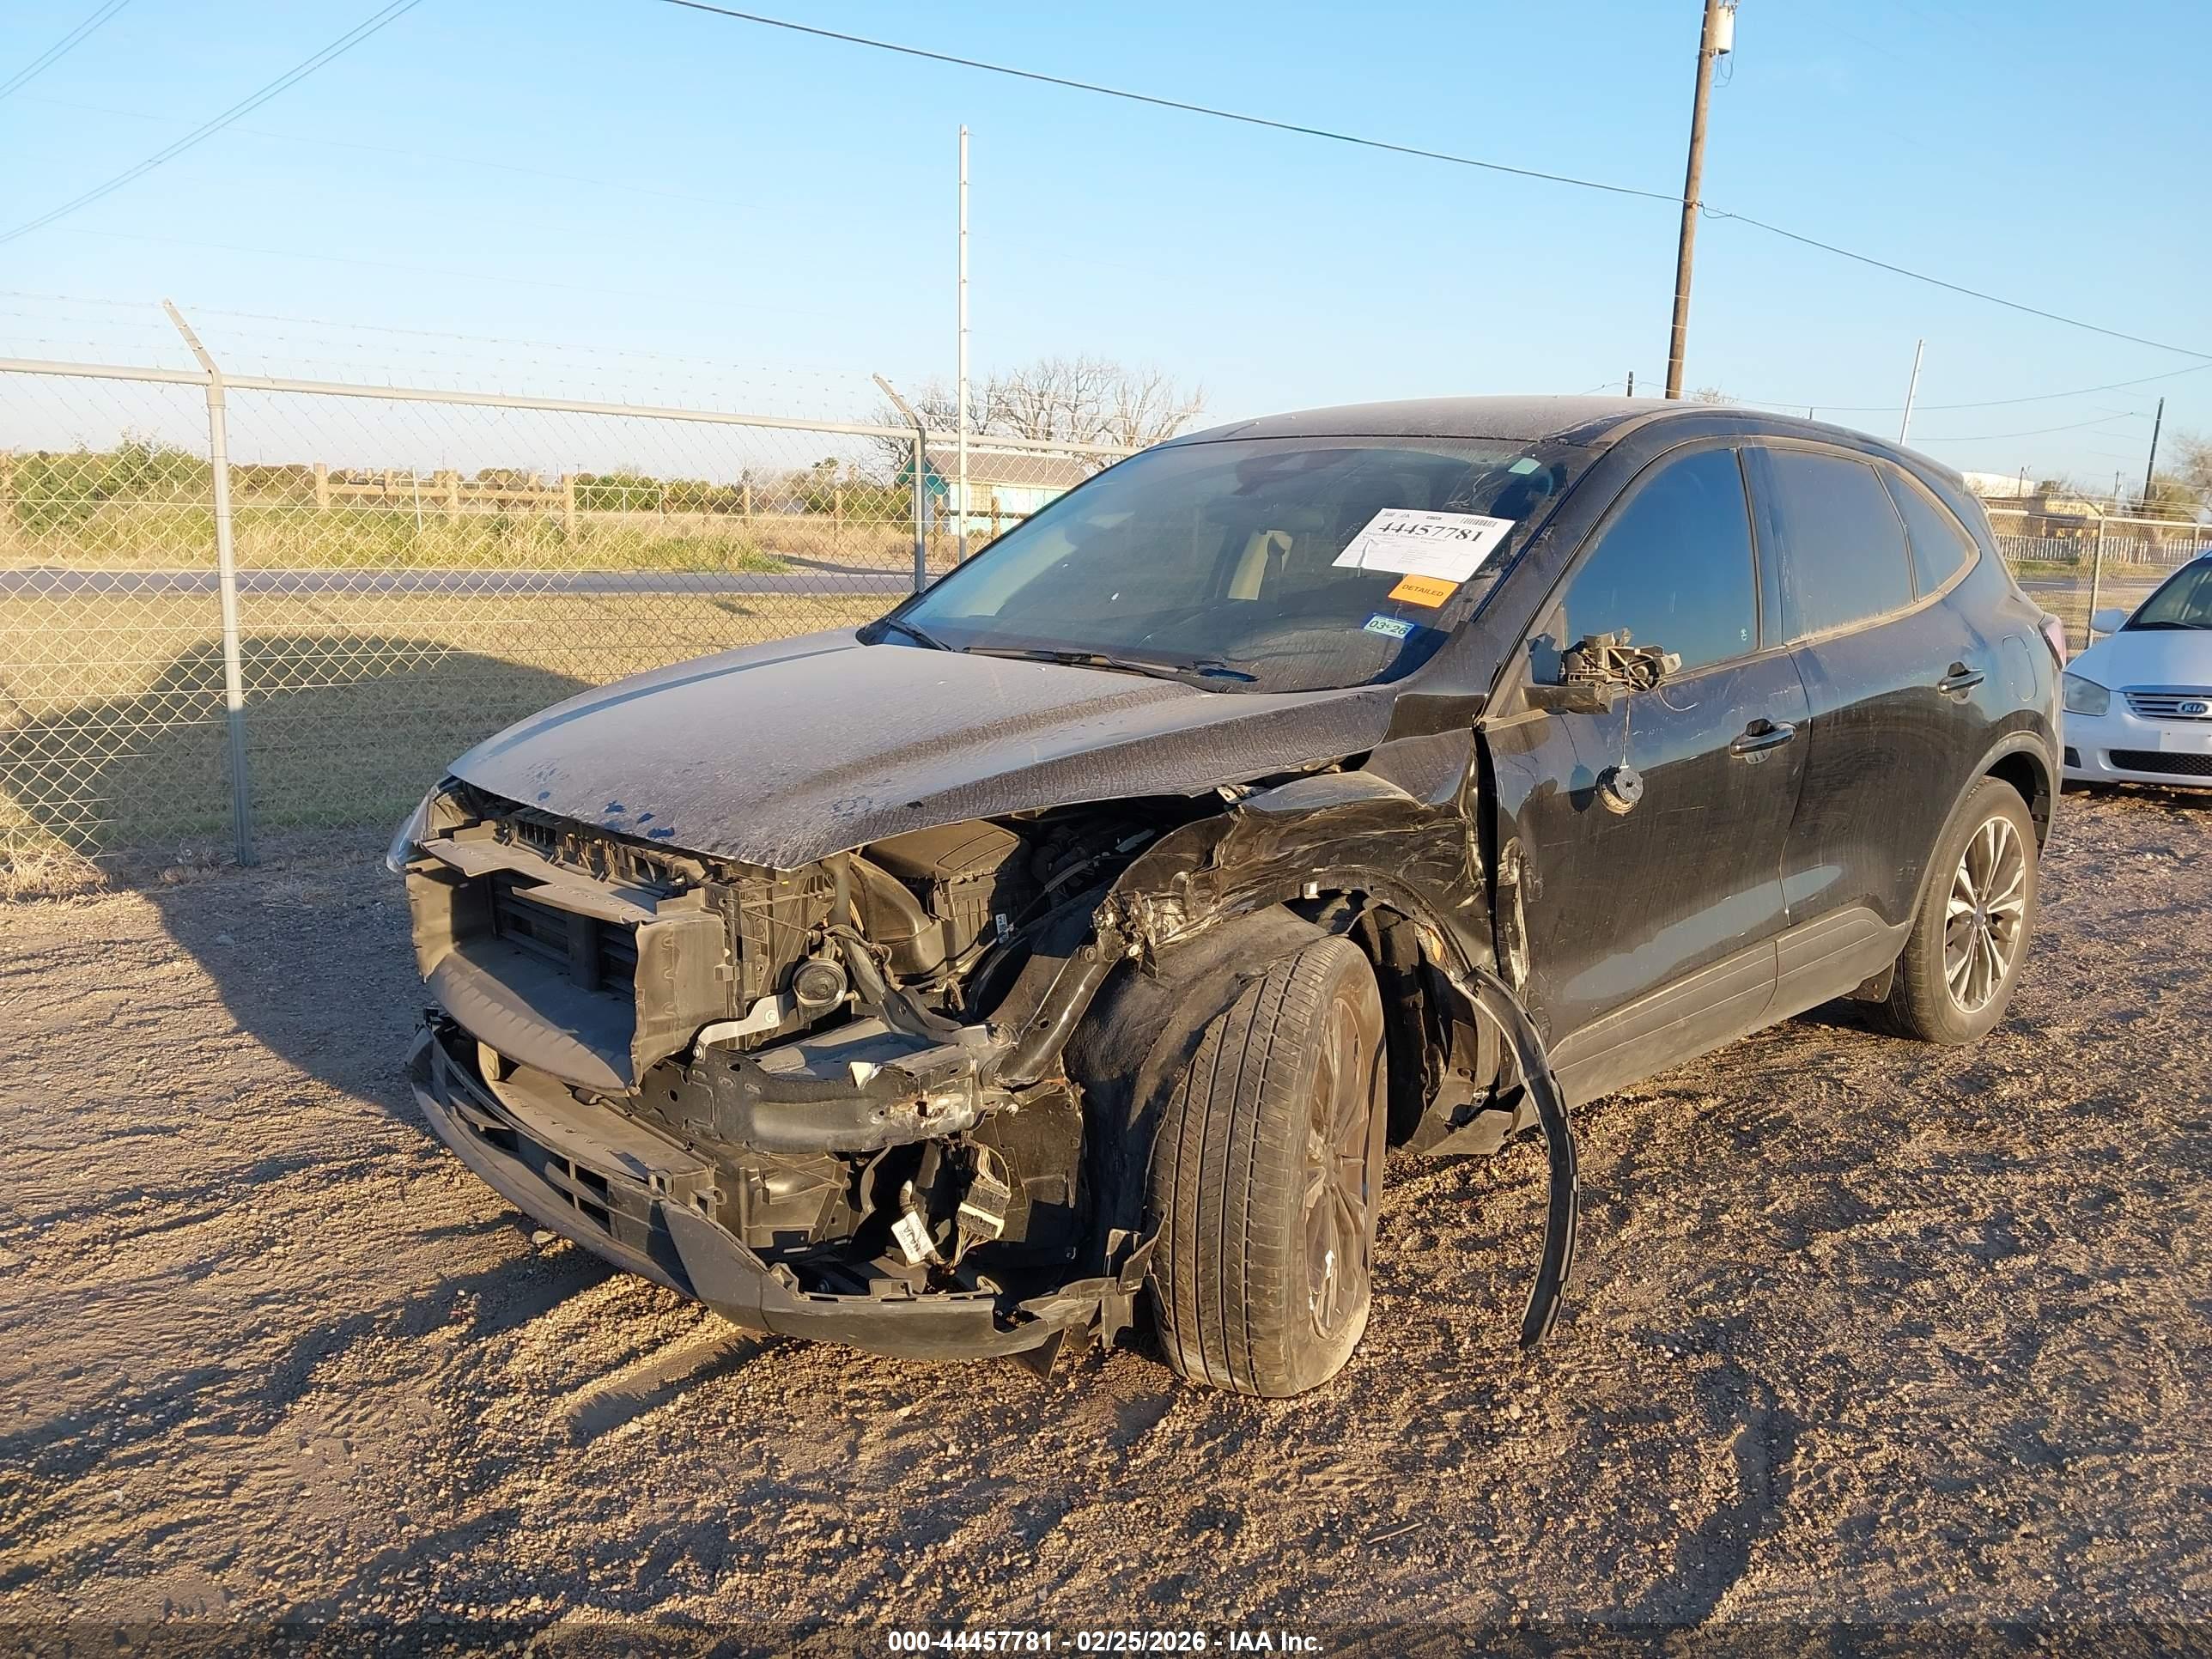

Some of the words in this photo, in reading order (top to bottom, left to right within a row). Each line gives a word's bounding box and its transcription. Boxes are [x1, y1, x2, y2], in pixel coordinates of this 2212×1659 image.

[1378, 521, 1484, 542] 44457781
[1401, 584, 1444, 597] DETAILED
[2184, 703, 2206, 713] KIA
